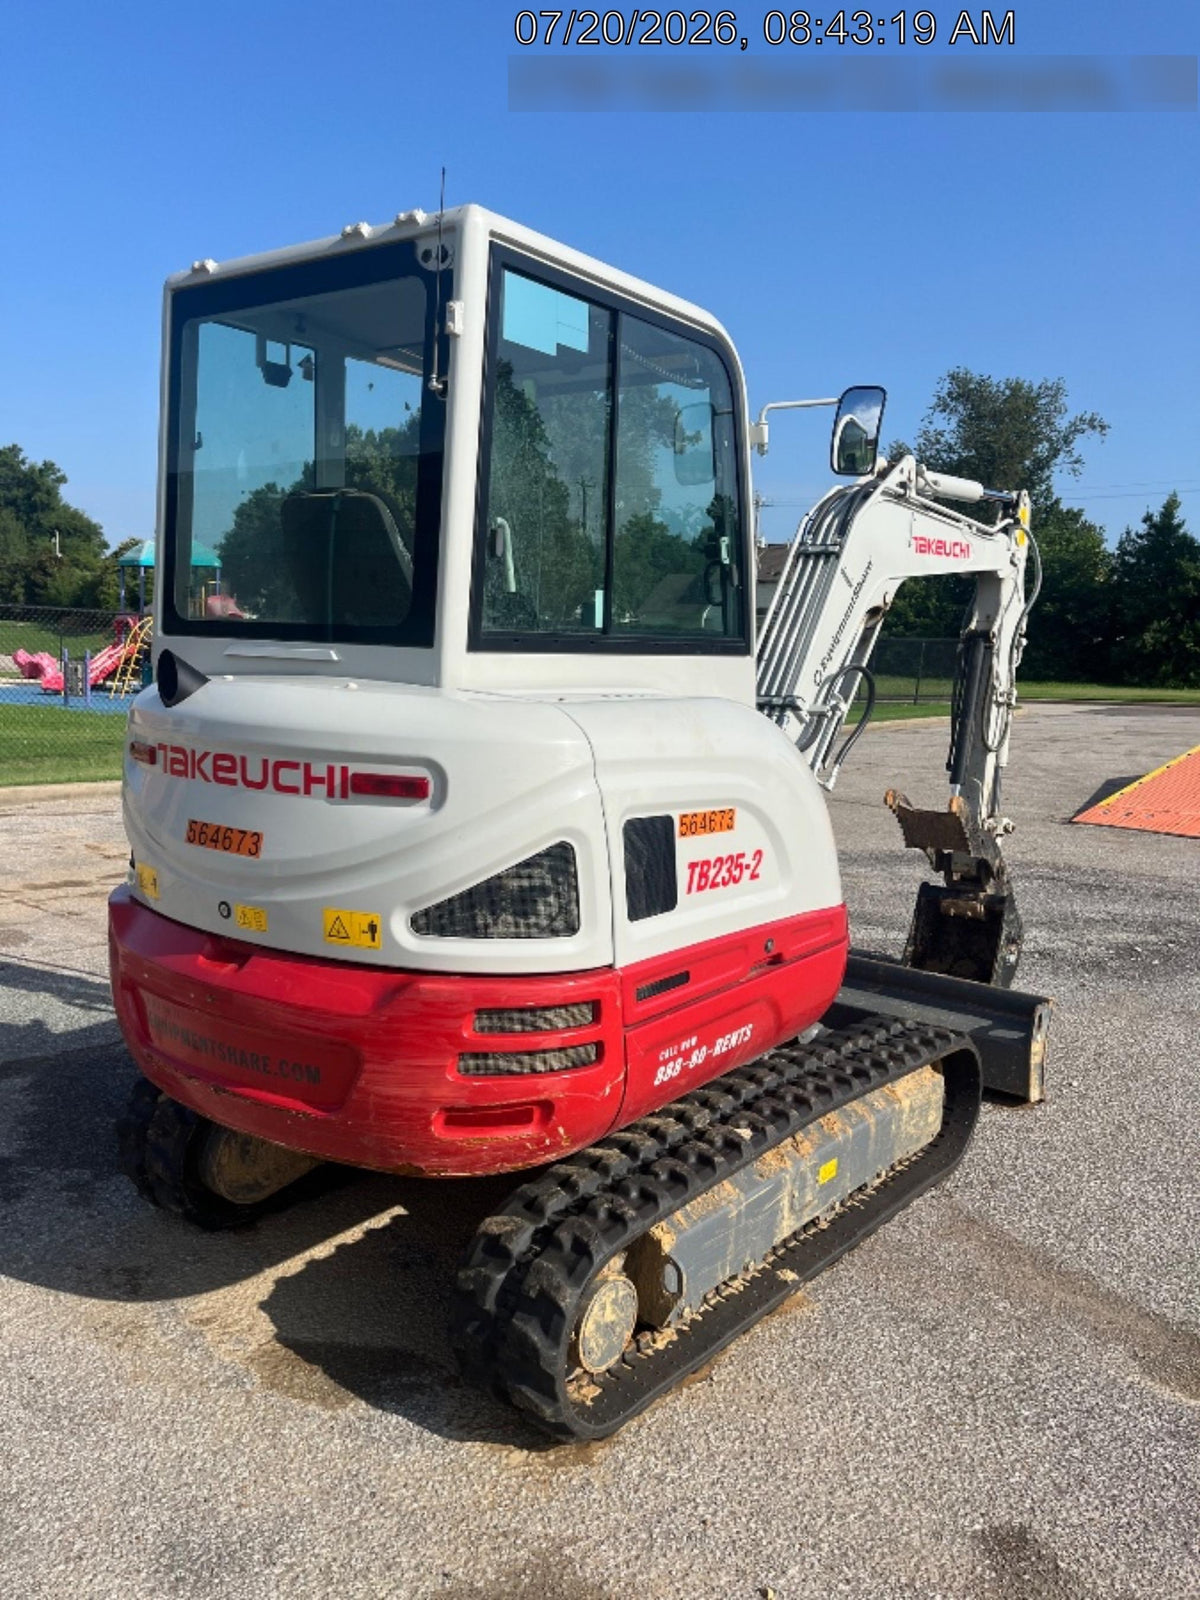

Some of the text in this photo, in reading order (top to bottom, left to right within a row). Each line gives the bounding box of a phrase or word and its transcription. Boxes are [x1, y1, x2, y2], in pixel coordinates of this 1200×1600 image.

[911, 536, 971, 559] TAKEUCHI
[186, 820, 261, 856] 564673
[679, 808, 735, 837] 564673
[686, 849, 763, 895] TB235-2
[654, 1024, 753, 1086] 888-80-RENTS
